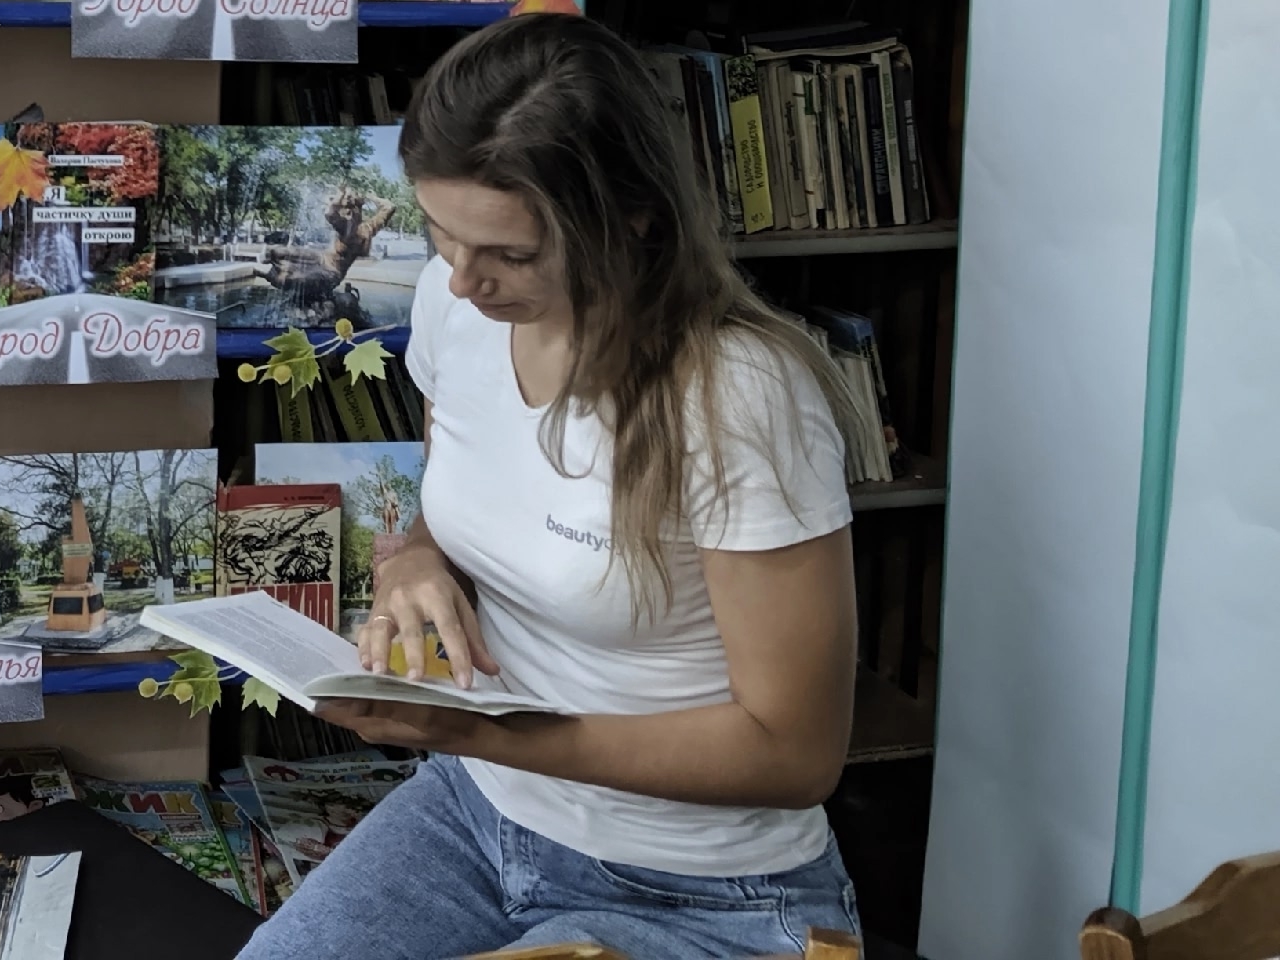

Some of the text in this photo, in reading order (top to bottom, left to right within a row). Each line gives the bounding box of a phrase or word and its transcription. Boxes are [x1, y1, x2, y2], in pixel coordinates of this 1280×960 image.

[36, 211, 133, 222] частичку души
[83, 312, 202, 362] Добра
